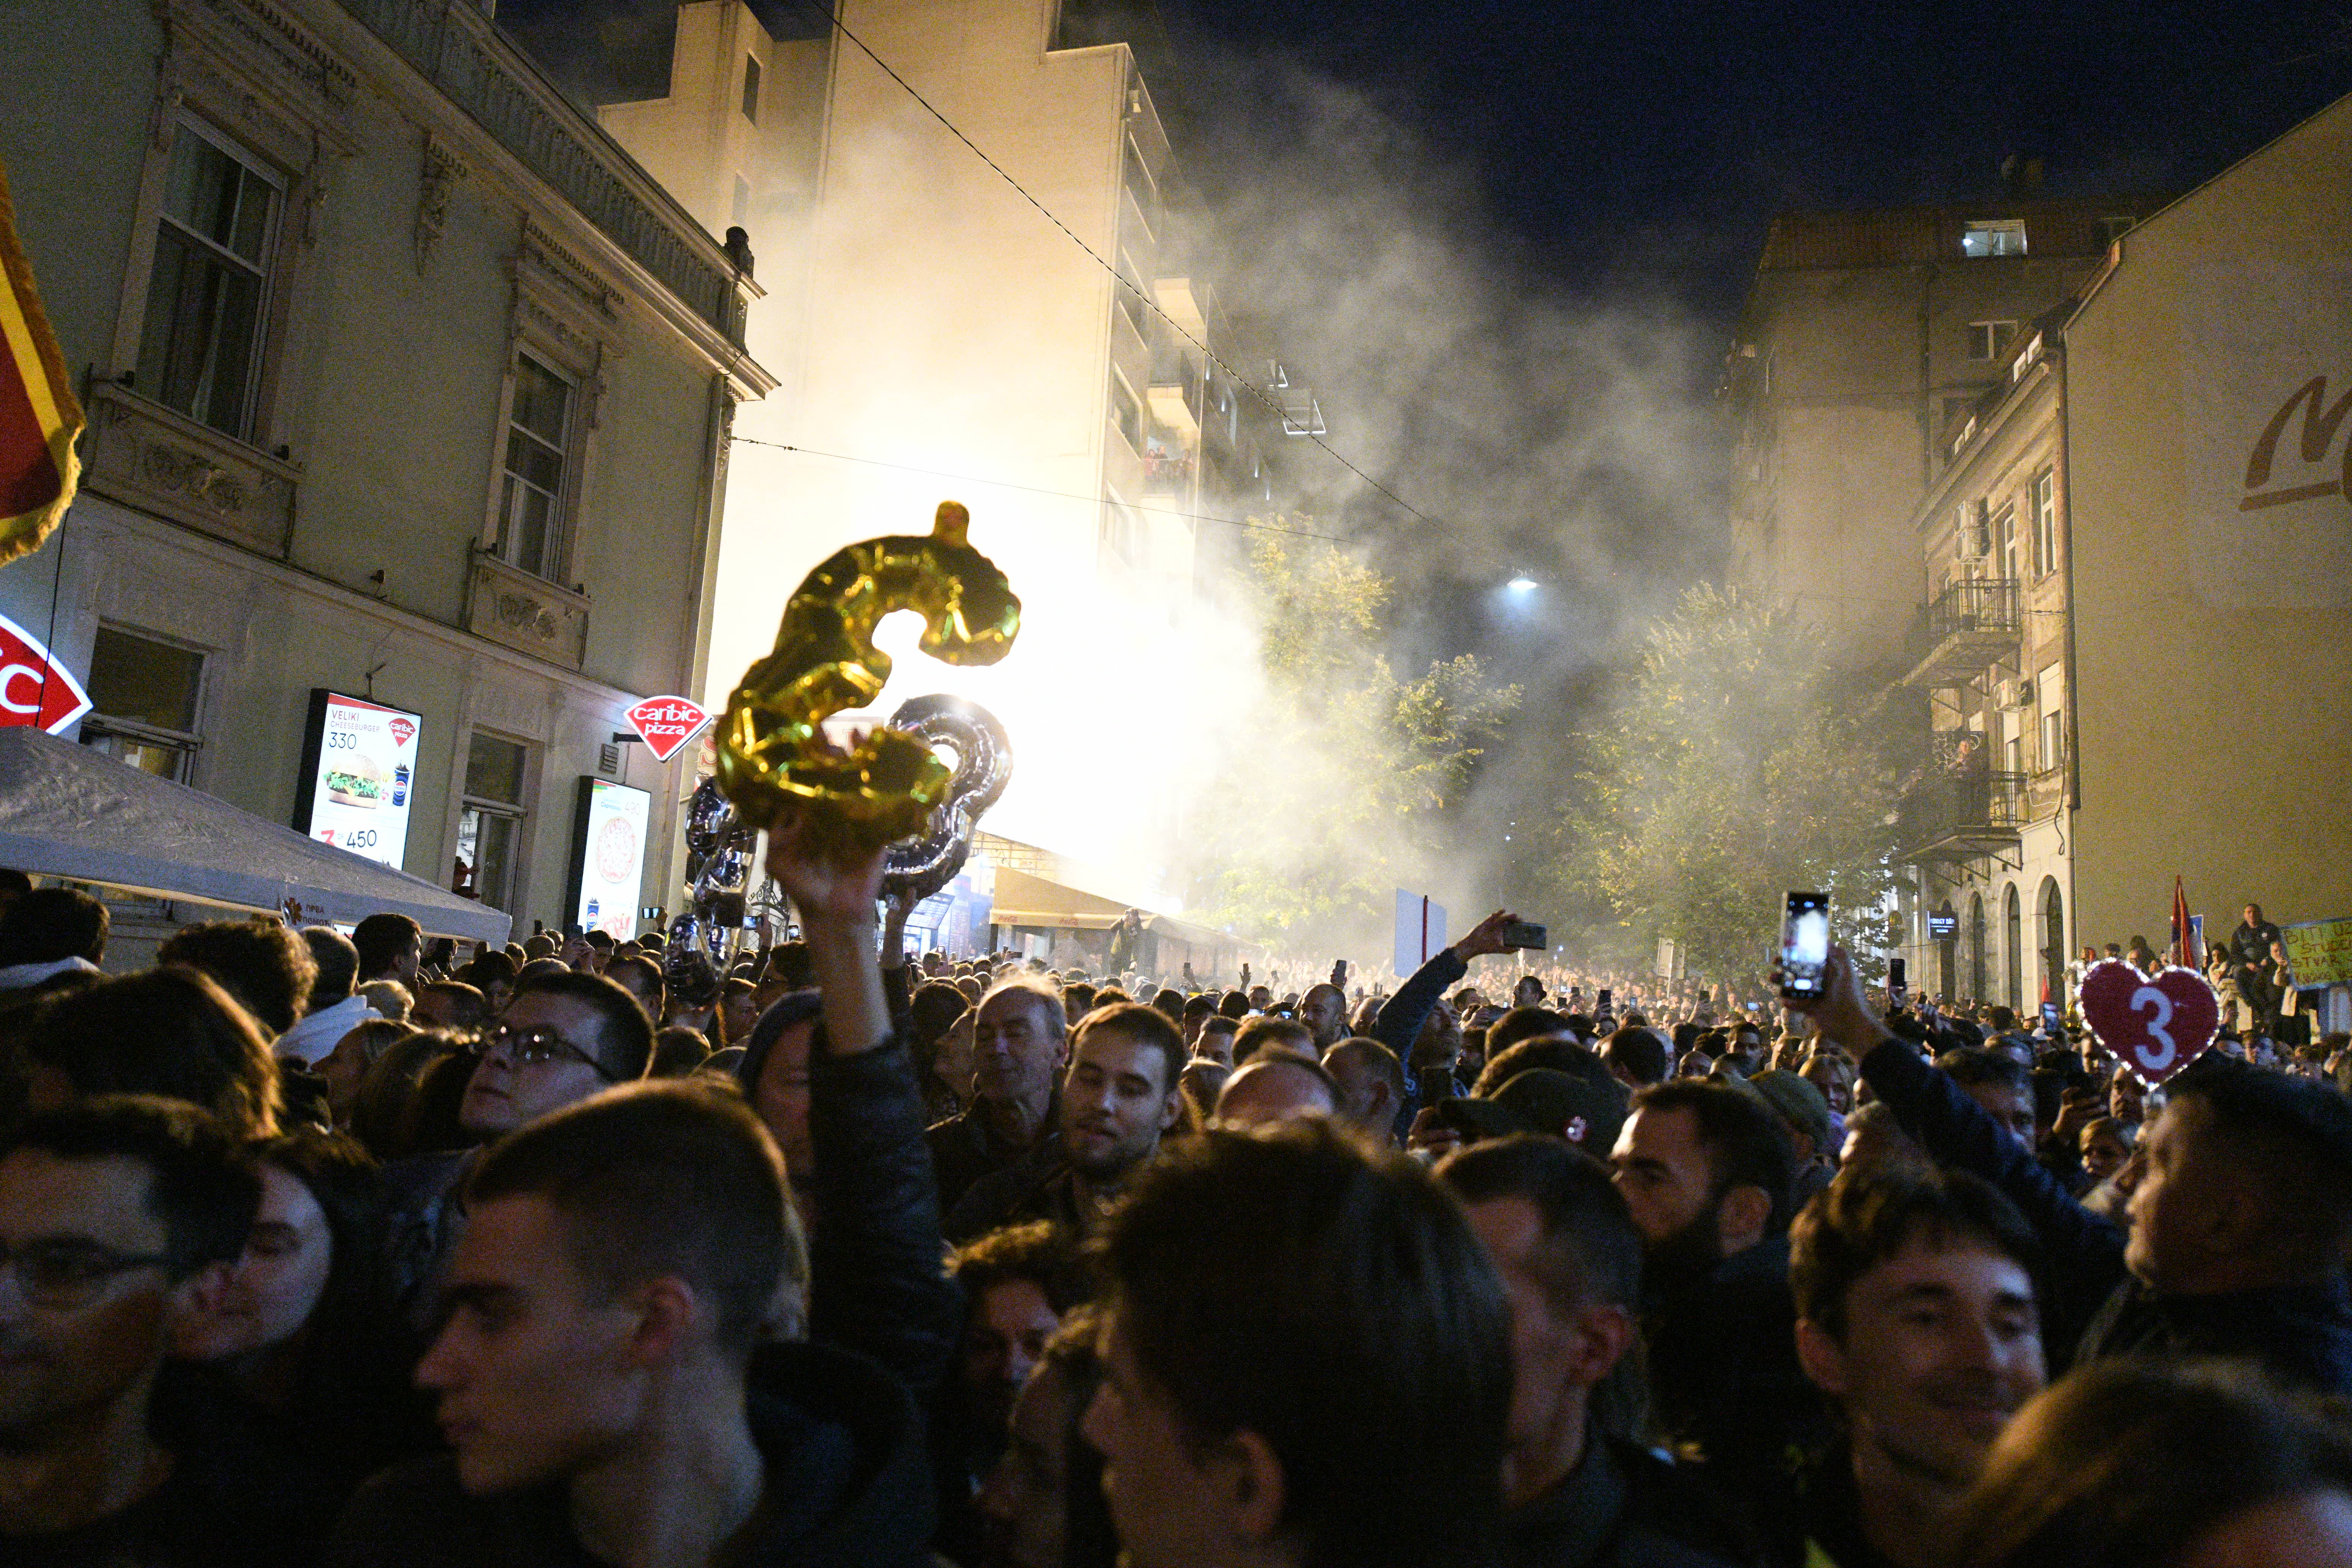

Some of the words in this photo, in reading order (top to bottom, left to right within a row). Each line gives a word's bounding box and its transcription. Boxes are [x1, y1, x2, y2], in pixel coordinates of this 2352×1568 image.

[332, 710, 359, 721] VELIKI
[634, 703, 698, 722] caribic
[330, 721, 380, 732] CHEESEBURGER
[390, 722, 414, 734] caribic
[644, 722, 685, 737] pizza
[329, 732, 356, 749] 330
[625, 801, 640, 815] 490
[346, 829, 377, 849] 450
[306, 904, 324, 914] ПРВА
[2284, 926, 2324, 944] BITI
[2301, 937, 2352, 954] STUDE
[2130, 987, 2176, 1070] 3
